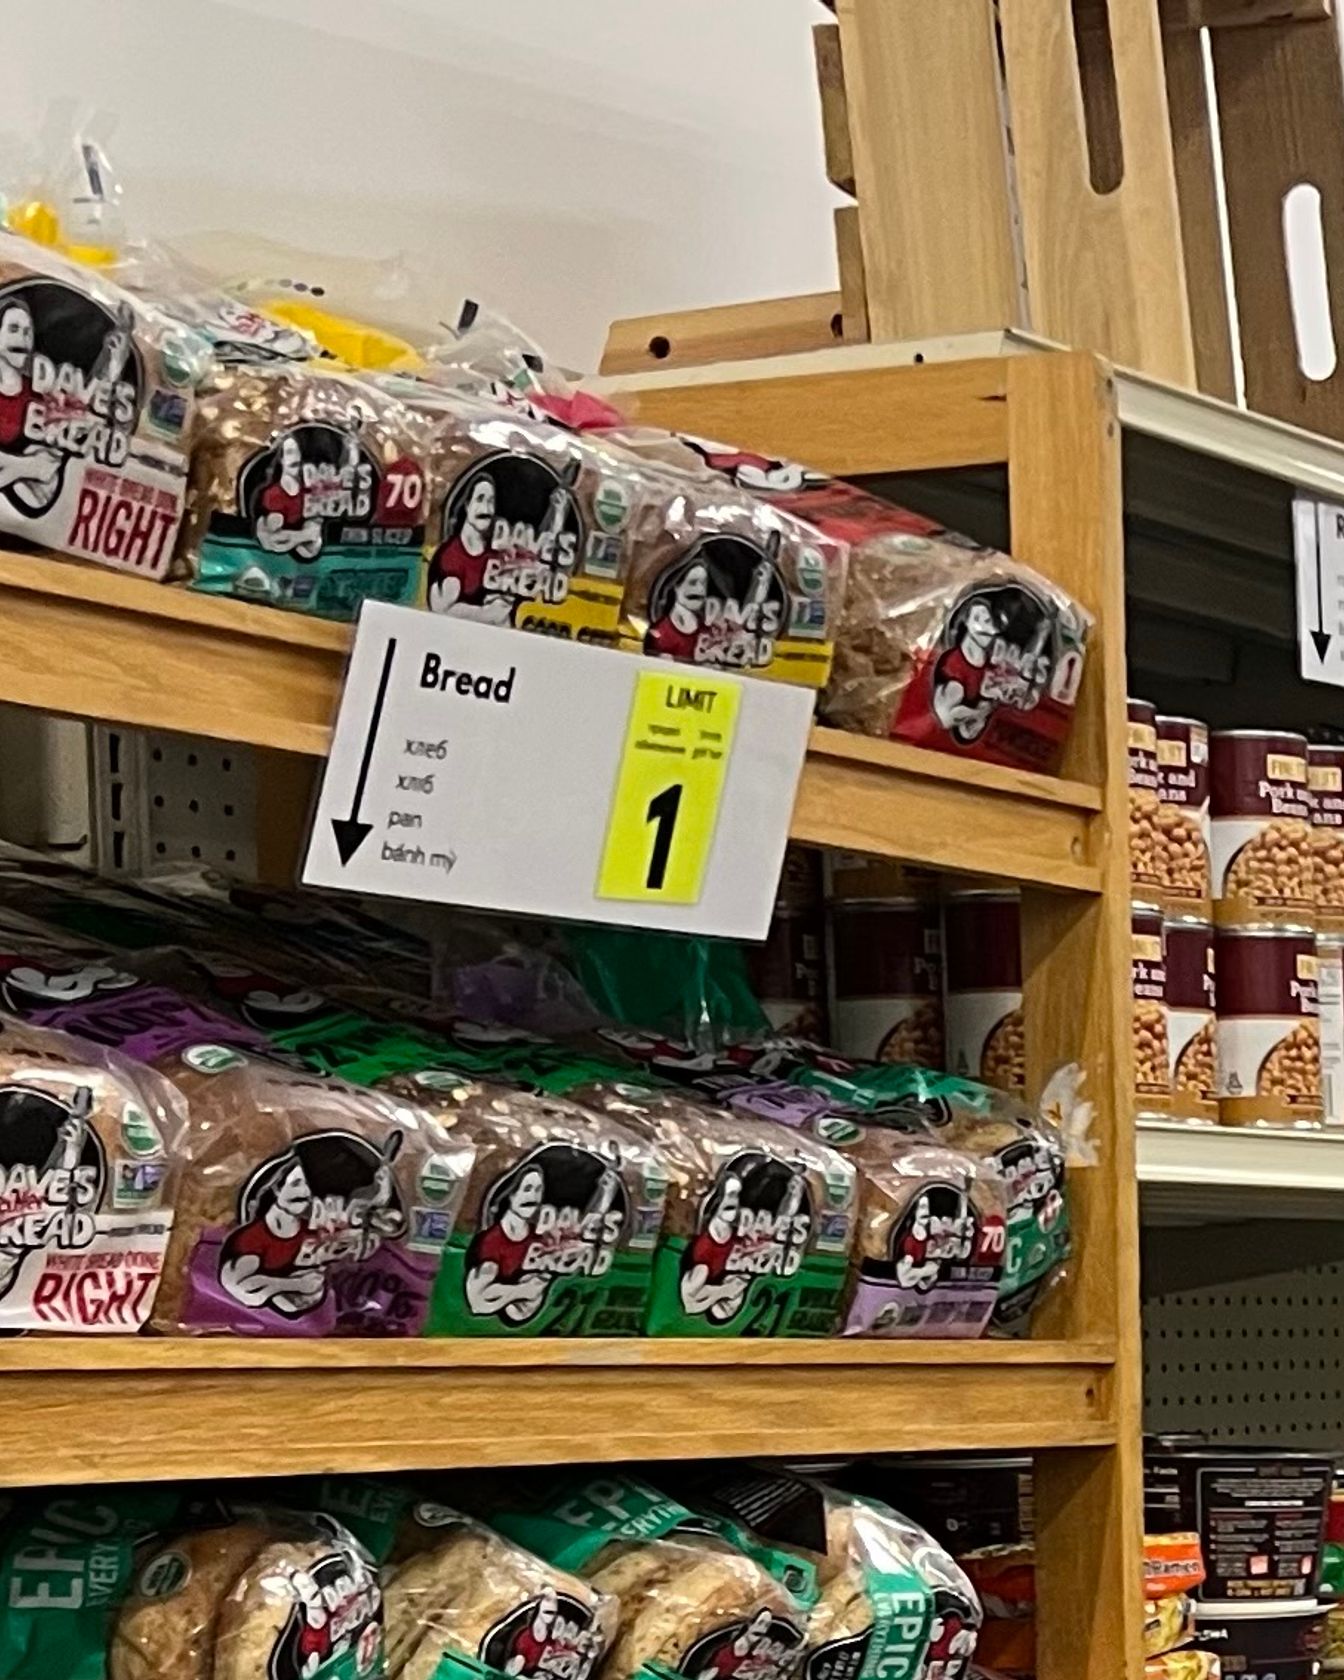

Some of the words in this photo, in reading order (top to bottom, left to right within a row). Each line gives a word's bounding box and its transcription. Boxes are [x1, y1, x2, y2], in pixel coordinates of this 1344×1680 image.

[24, 405, 131, 467] BREAD
[383, 474, 421, 508] 70
[68, 489, 178, 574] RIGHT
[420, 652, 516, 703] Bread
[666, 685, 718, 713] LIMIT
[646, 783, 683, 890] 1
[33, 1272, 158, 1324] RIGHT
[875, 1593, 926, 1679] EPIC
